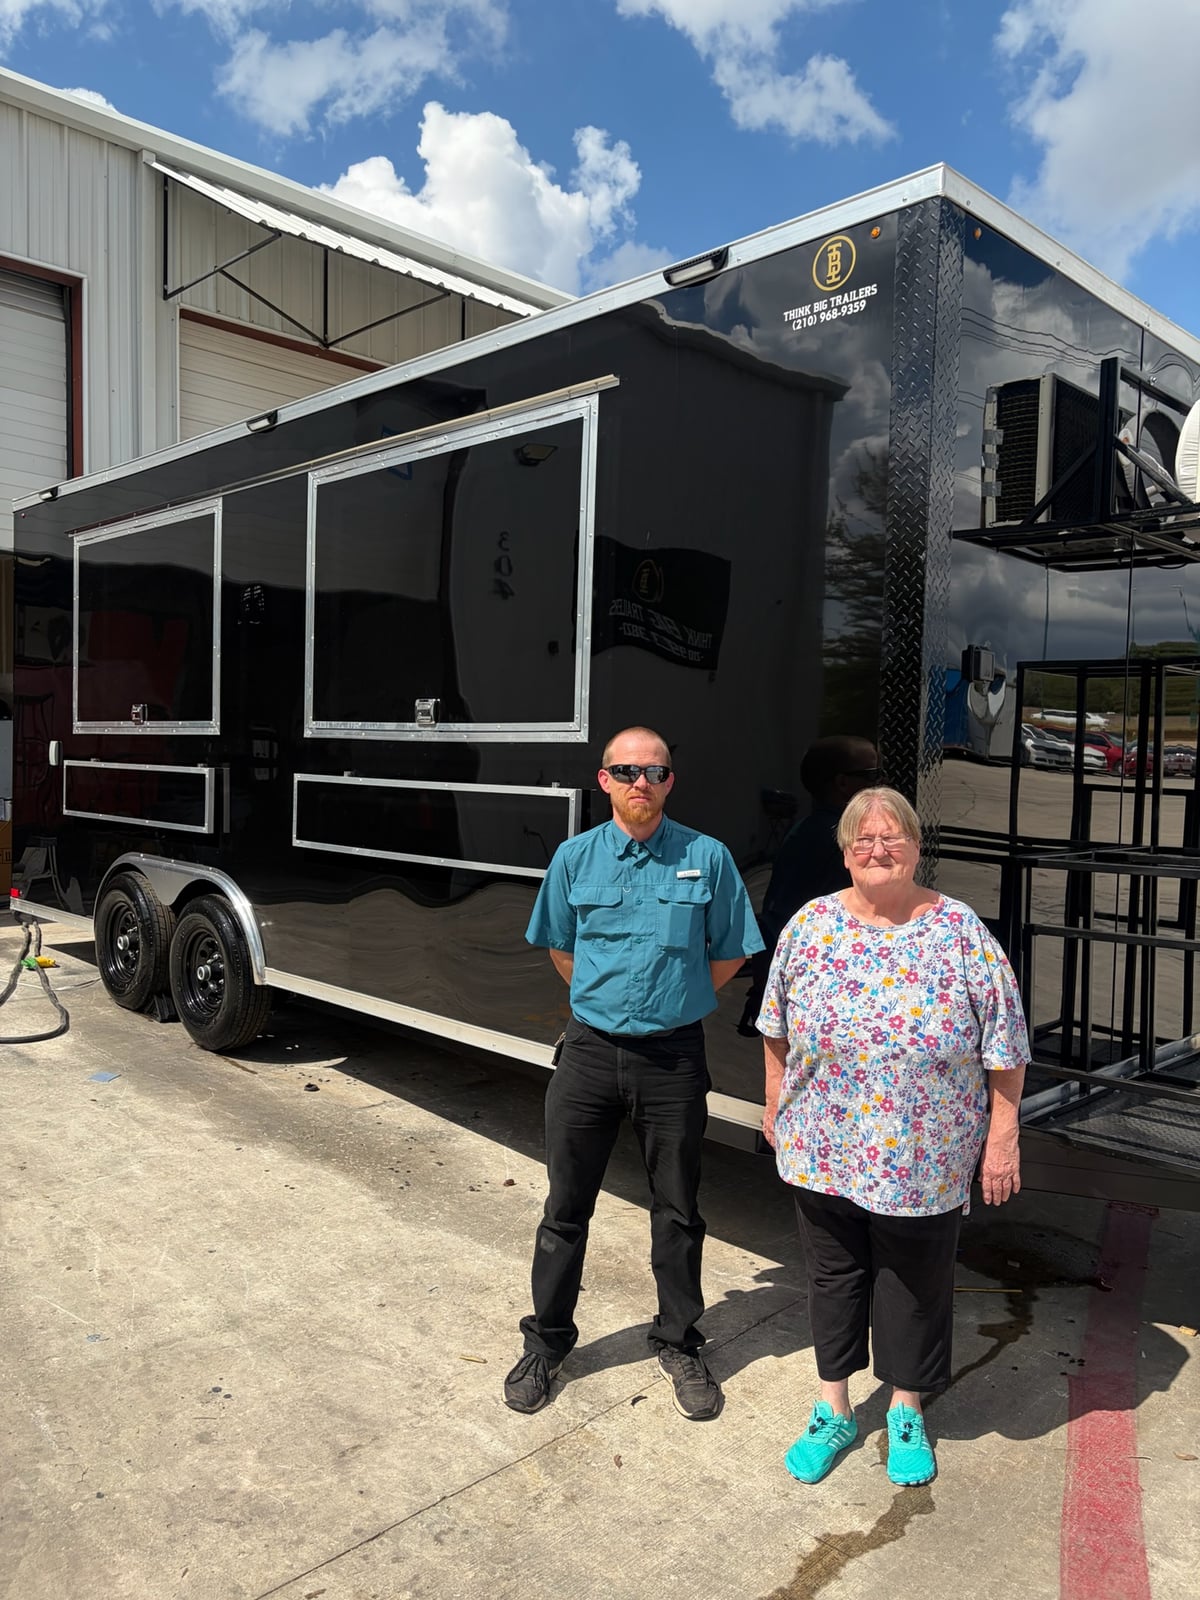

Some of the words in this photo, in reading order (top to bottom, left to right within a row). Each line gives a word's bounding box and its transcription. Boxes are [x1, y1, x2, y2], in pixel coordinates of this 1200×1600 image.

[783, 304, 812, 322] THINK
[813, 299, 828, 314] BIG
[829, 283, 878, 308] TRAILERS
[792, 315, 817, 331] (210)
[820, 299, 867, 323] 968-9359
